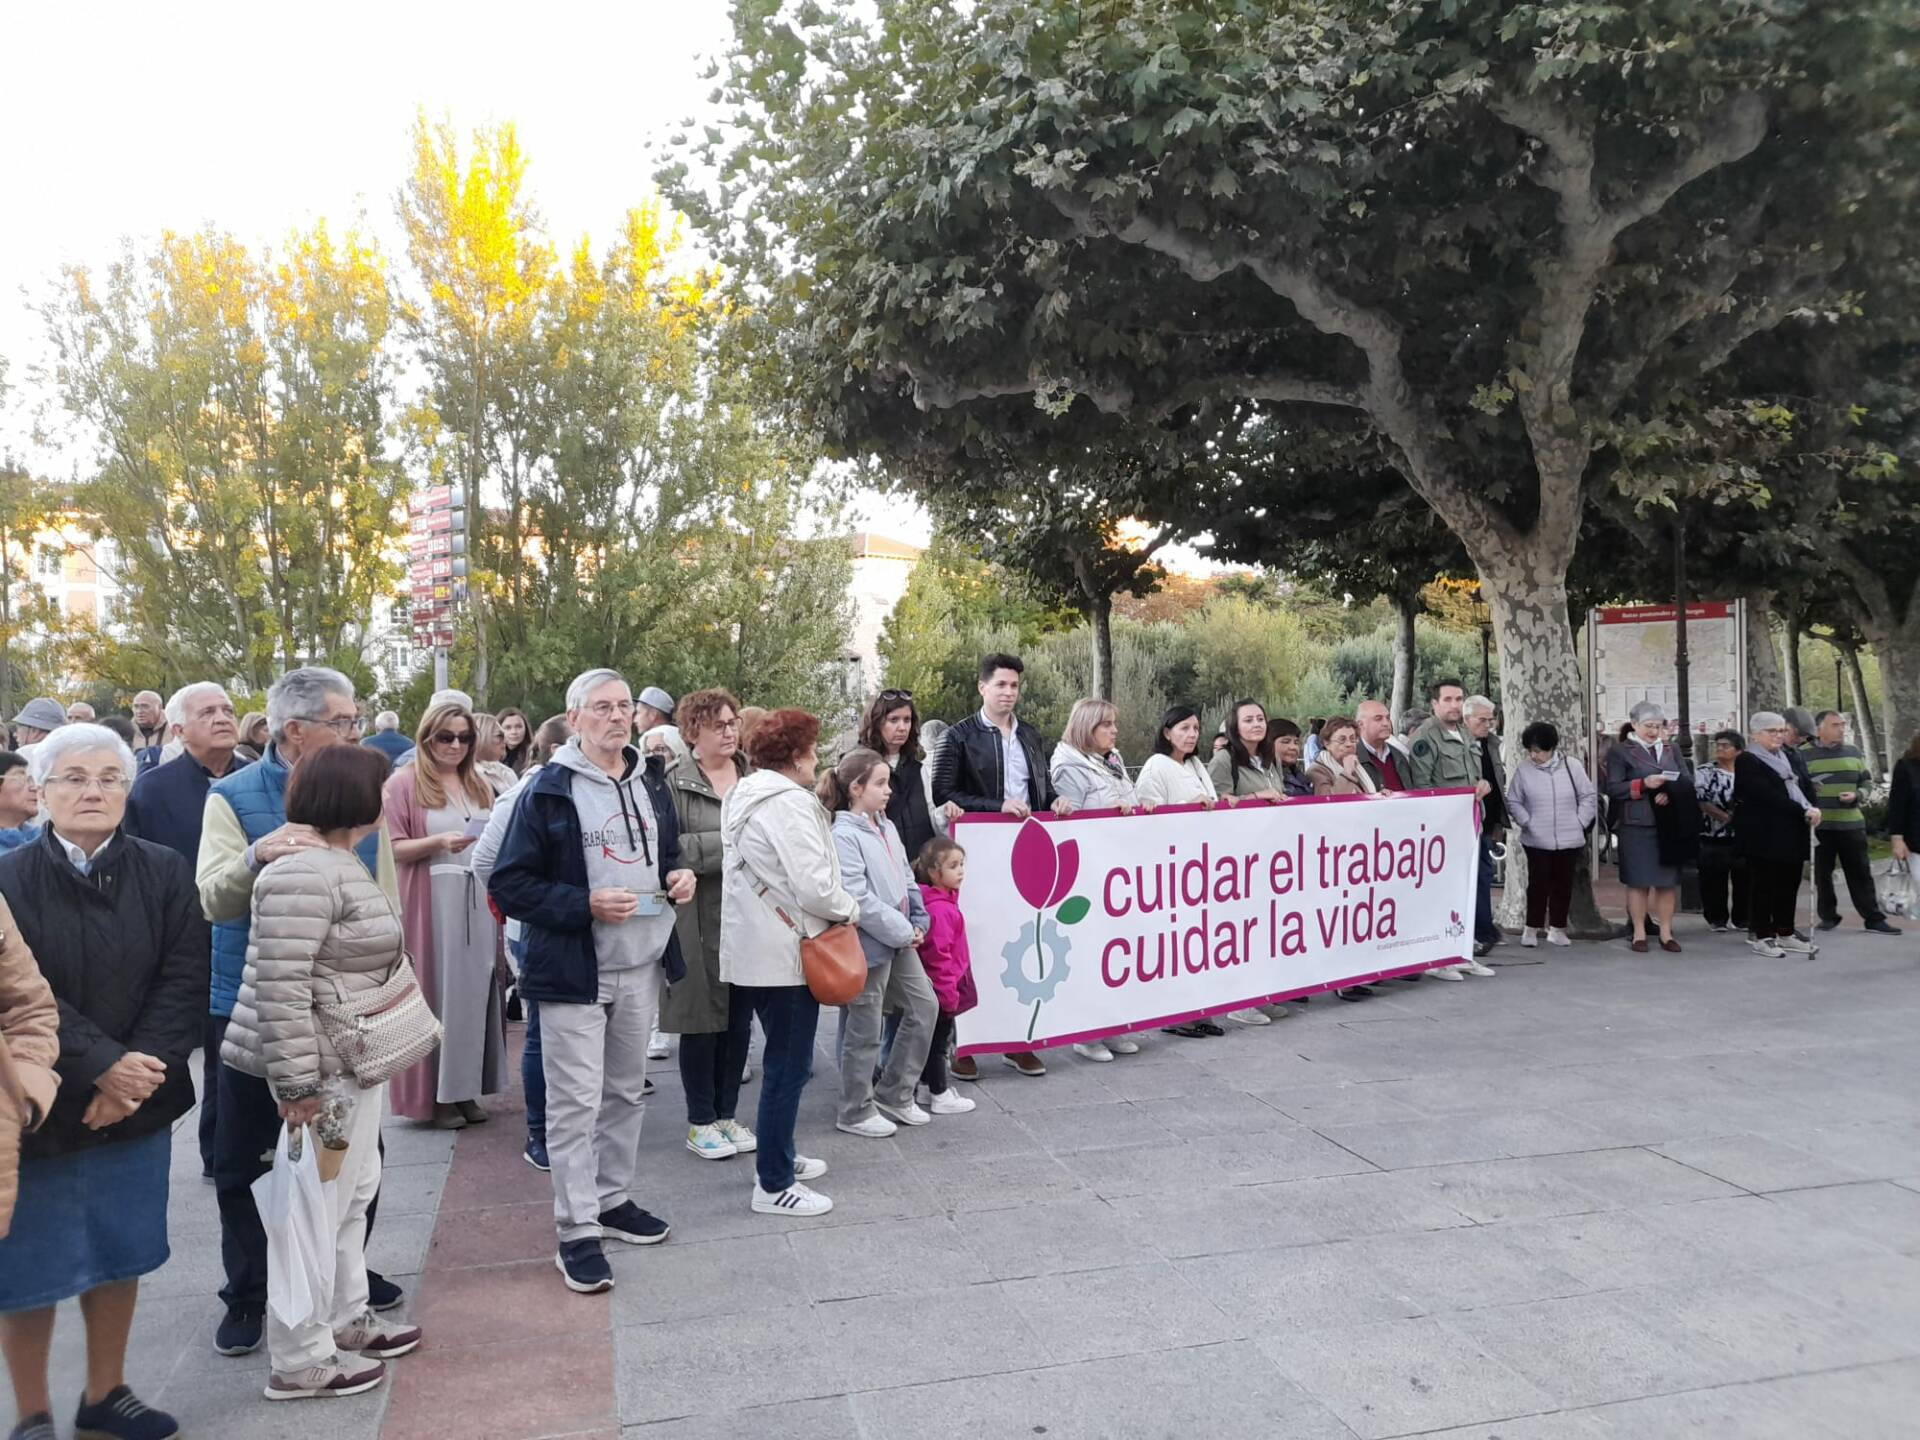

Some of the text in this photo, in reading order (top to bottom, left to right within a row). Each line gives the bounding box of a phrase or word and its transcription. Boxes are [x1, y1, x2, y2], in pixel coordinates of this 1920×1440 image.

[1103, 823, 1446, 918] cuidar el trabajo
[1101, 886, 1397, 988] cuidar la vida
